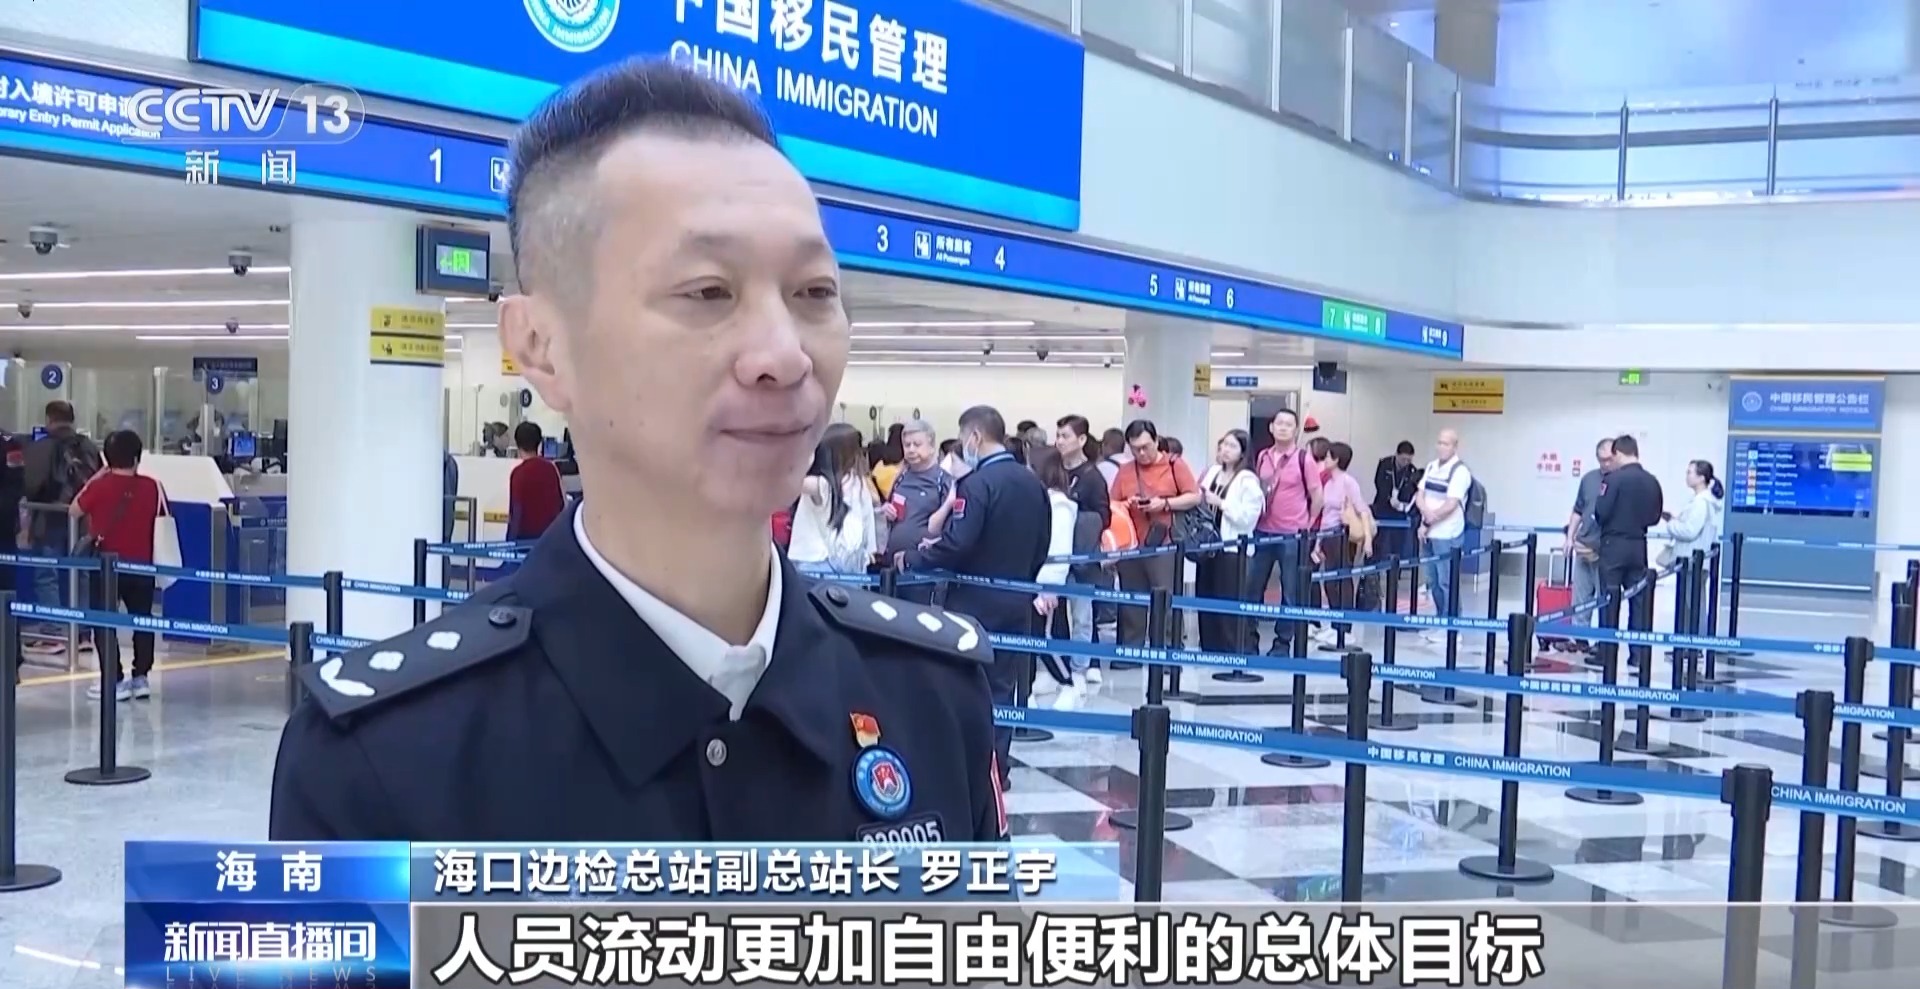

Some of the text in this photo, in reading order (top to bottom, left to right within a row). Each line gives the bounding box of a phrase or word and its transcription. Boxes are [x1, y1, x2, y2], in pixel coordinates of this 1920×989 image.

[776, 66, 939, 138] IMMIGRATION
[29, 108, 60, 128] Entry
[61, 113, 100, 132] Permit
[429, 148, 442, 184] 1
[876, 224, 889, 253] 3
[994, 245, 1006, 271] 4
[1150, 273, 1159, 297] 5
[1226, 287, 1235, 309] 6
[1329, 307, 1336, 328] 7
[48, 371, 57, 384] 2
[211, 377, 219, 390] 3
[1001, 635, 1048, 648] IMMIGRATION
[1172, 652, 1196, 662] CHINA
[1196, 654, 1247, 666] IMMIGRATION
[1380, 665, 1436, 680] IMMIGRATION
[1588, 686, 1617, 697] CHINA
[1618, 689, 1680, 702] IMMIGRATION
[994, 709, 1025, 721] RATION
[1833, 704, 1896, 720] MMIGRATION
[1169, 724, 1263, 745] HINA IMMIGRATION
[1367, 746, 1571, 778] 中国移民管理 CHINA IMMIGRATION
[1770, 786, 1907, 815] CHINA IMMIGRATION
